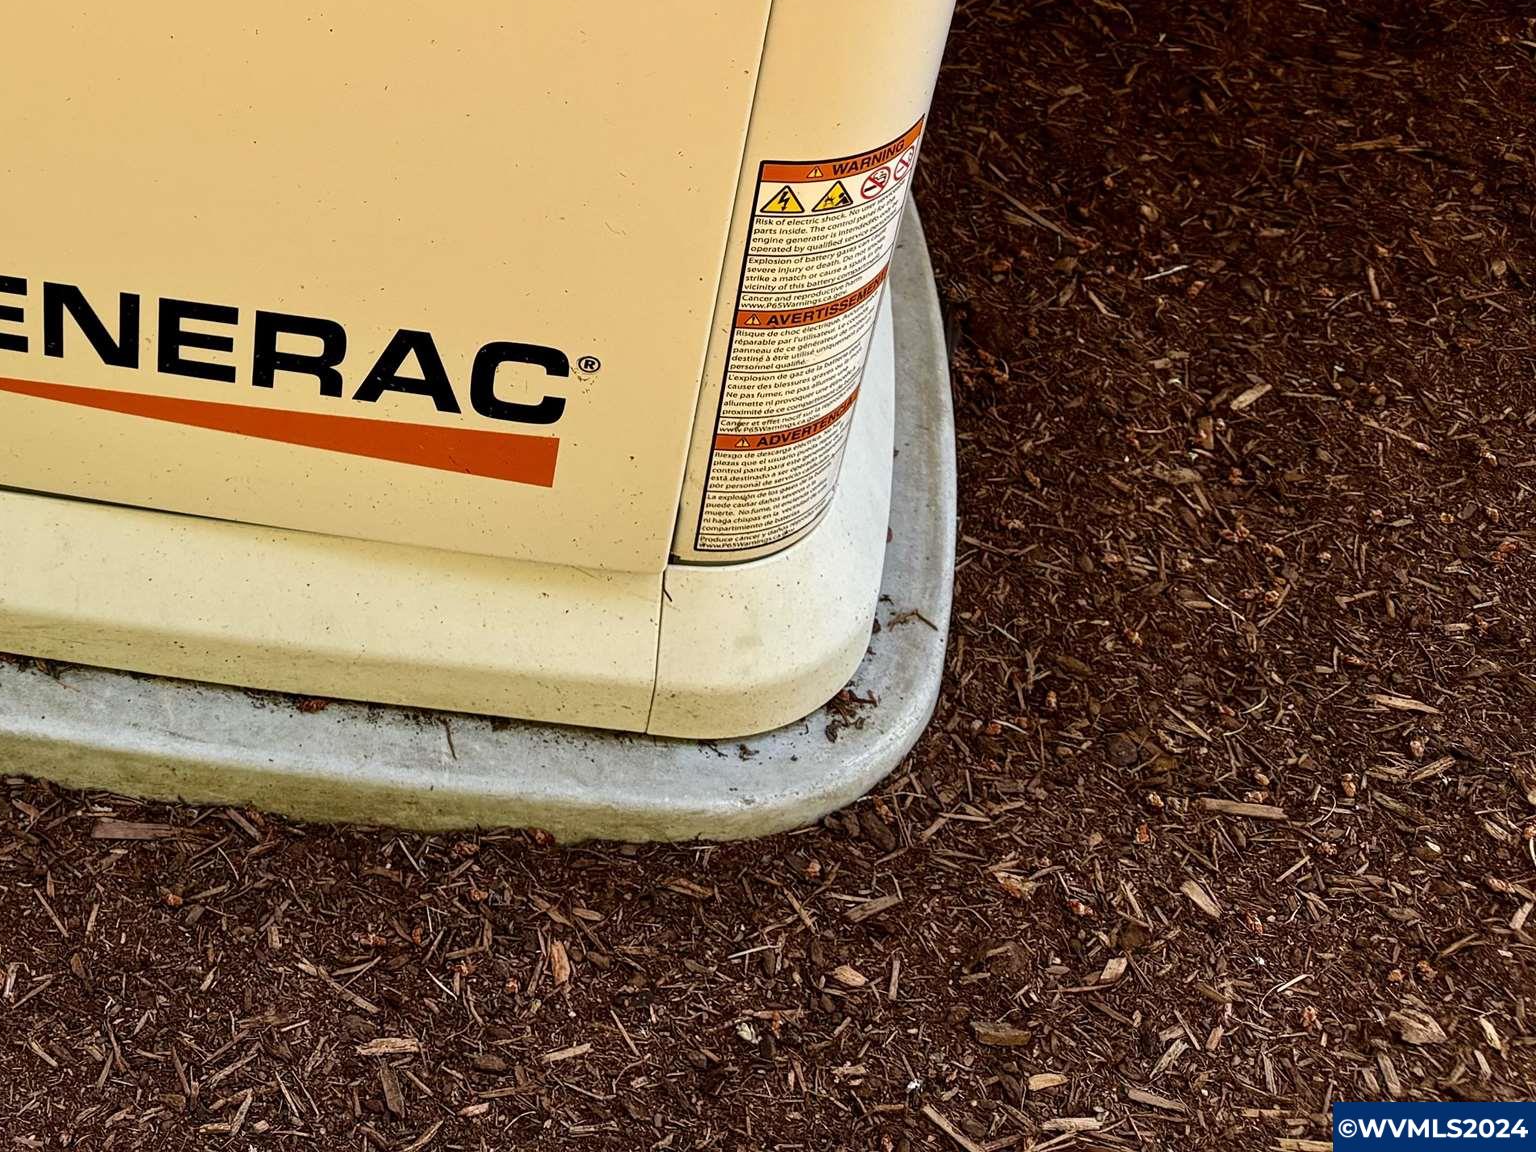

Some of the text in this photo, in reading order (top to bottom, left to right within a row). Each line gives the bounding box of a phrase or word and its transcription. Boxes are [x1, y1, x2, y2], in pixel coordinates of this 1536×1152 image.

[832, 140, 905, 176] WARNING
[786, 217, 819, 226] electric
[849, 207, 860, 216] No
[754, 228, 777, 236] parts
[810, 225, 826, 233] The
[827, 217, 855, 230] control
[752, 236, 784, 245] engine
[785, 233, 829, 245] generator
[751, 245, 792, 254] operated
[793, 245, 804, 253] by
[807, 238, 843, 252] qualified
[748, 257, 792, 266] Explosion
[805, 252, 835, 264] battery
[746, 274, 770, 282] strike
[779, 274, 807, 282] match
[819, 267, 841, 277] cause
[778, 266, 803, 275] injury
[744, 283, 775, 292] vicinity
[789, 282, 805, 290] this
[806, 275, 836, 289] battery
[742, 294, 773, 302] Cancer
[793, 283, 845, 302] reproductive
[736, 330, 765, 339] Risque
[780, 328, 801, 337] choc
[735, 338, 776, 347] réparable
[777, 339, 791, 347] par
[732, 354, 764, 362] destiné
[730, 363, 774, 371] personnel
[790, 371, 803, 380] gaz
[796, 385, 809, 394] pas
[723, 408, 762, 417] proximité
[743, 465, 767, 474] panel
[725, 481, 761, 490] personal
[706, 501, 731, 509] puede
[712, 517, 732, 525] haga
